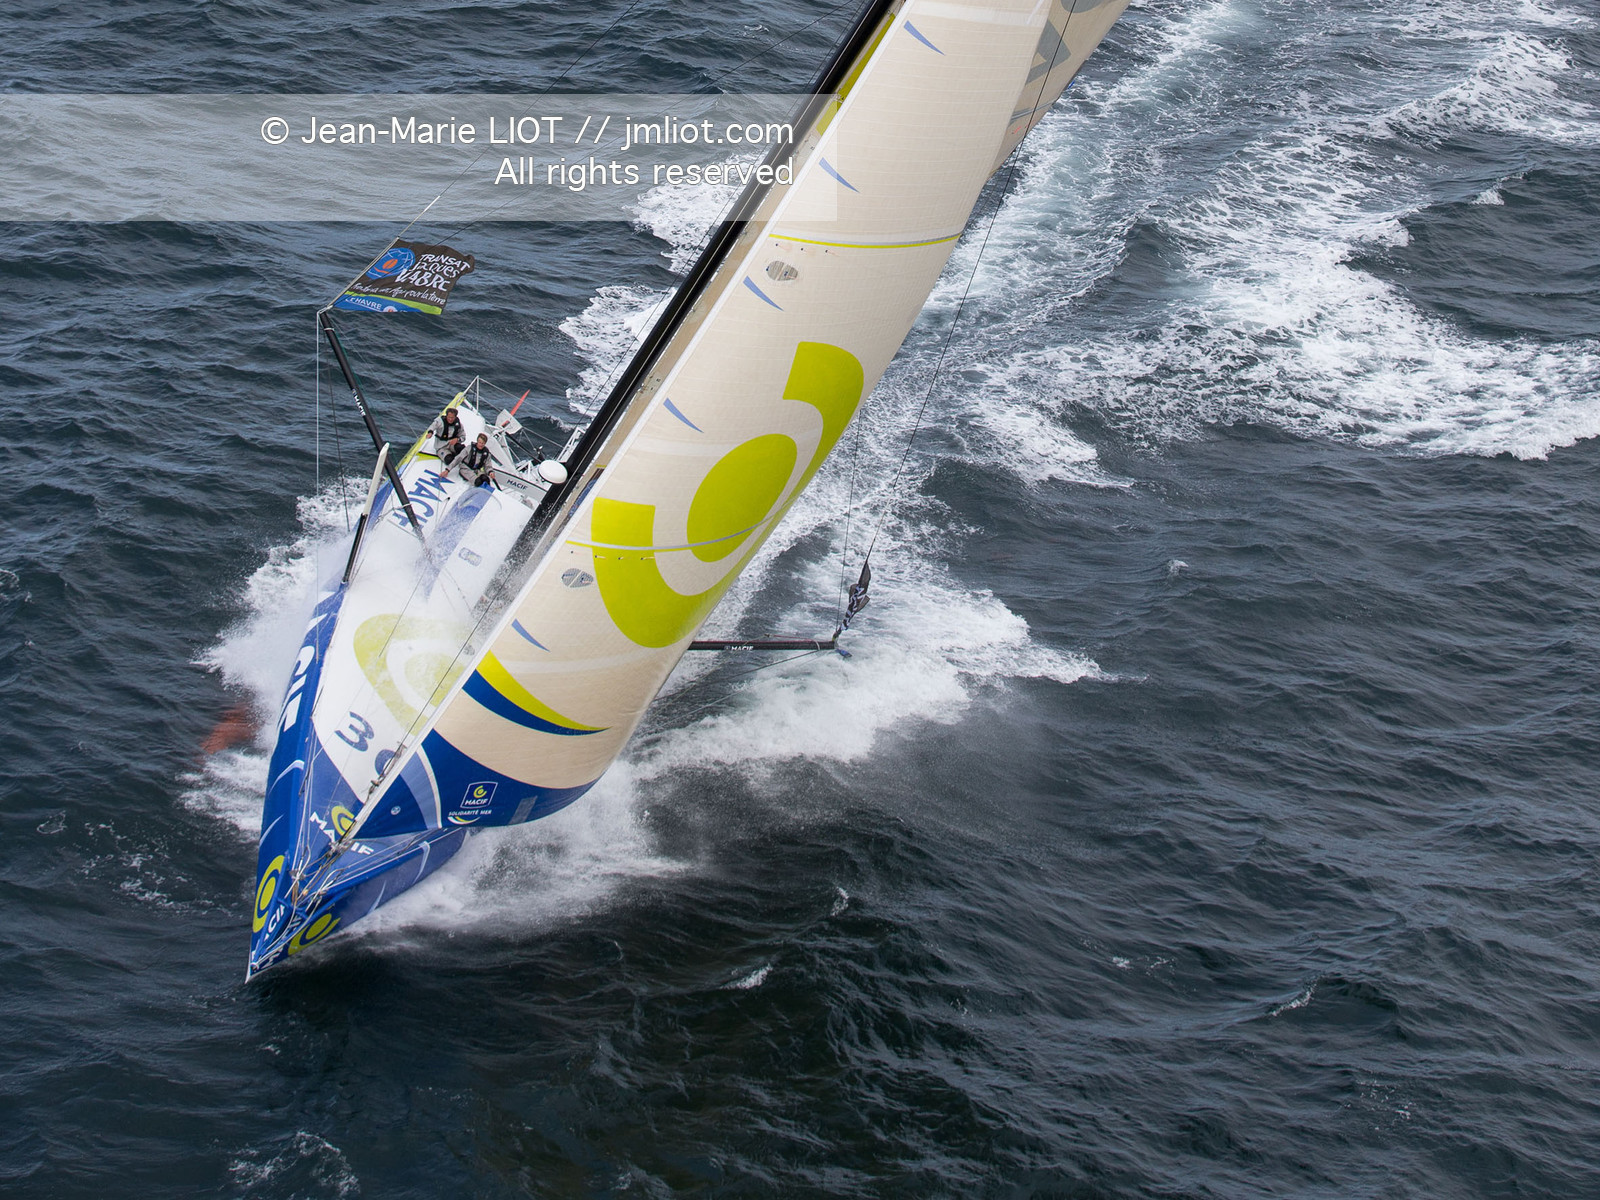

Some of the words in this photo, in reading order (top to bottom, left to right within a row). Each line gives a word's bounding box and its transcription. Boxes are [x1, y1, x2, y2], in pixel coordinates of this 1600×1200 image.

[420, 254, 471, 271] TRANSAT
[506, 478, 528, 491] MACIF
[464, 798, 489, 806] MACIF
